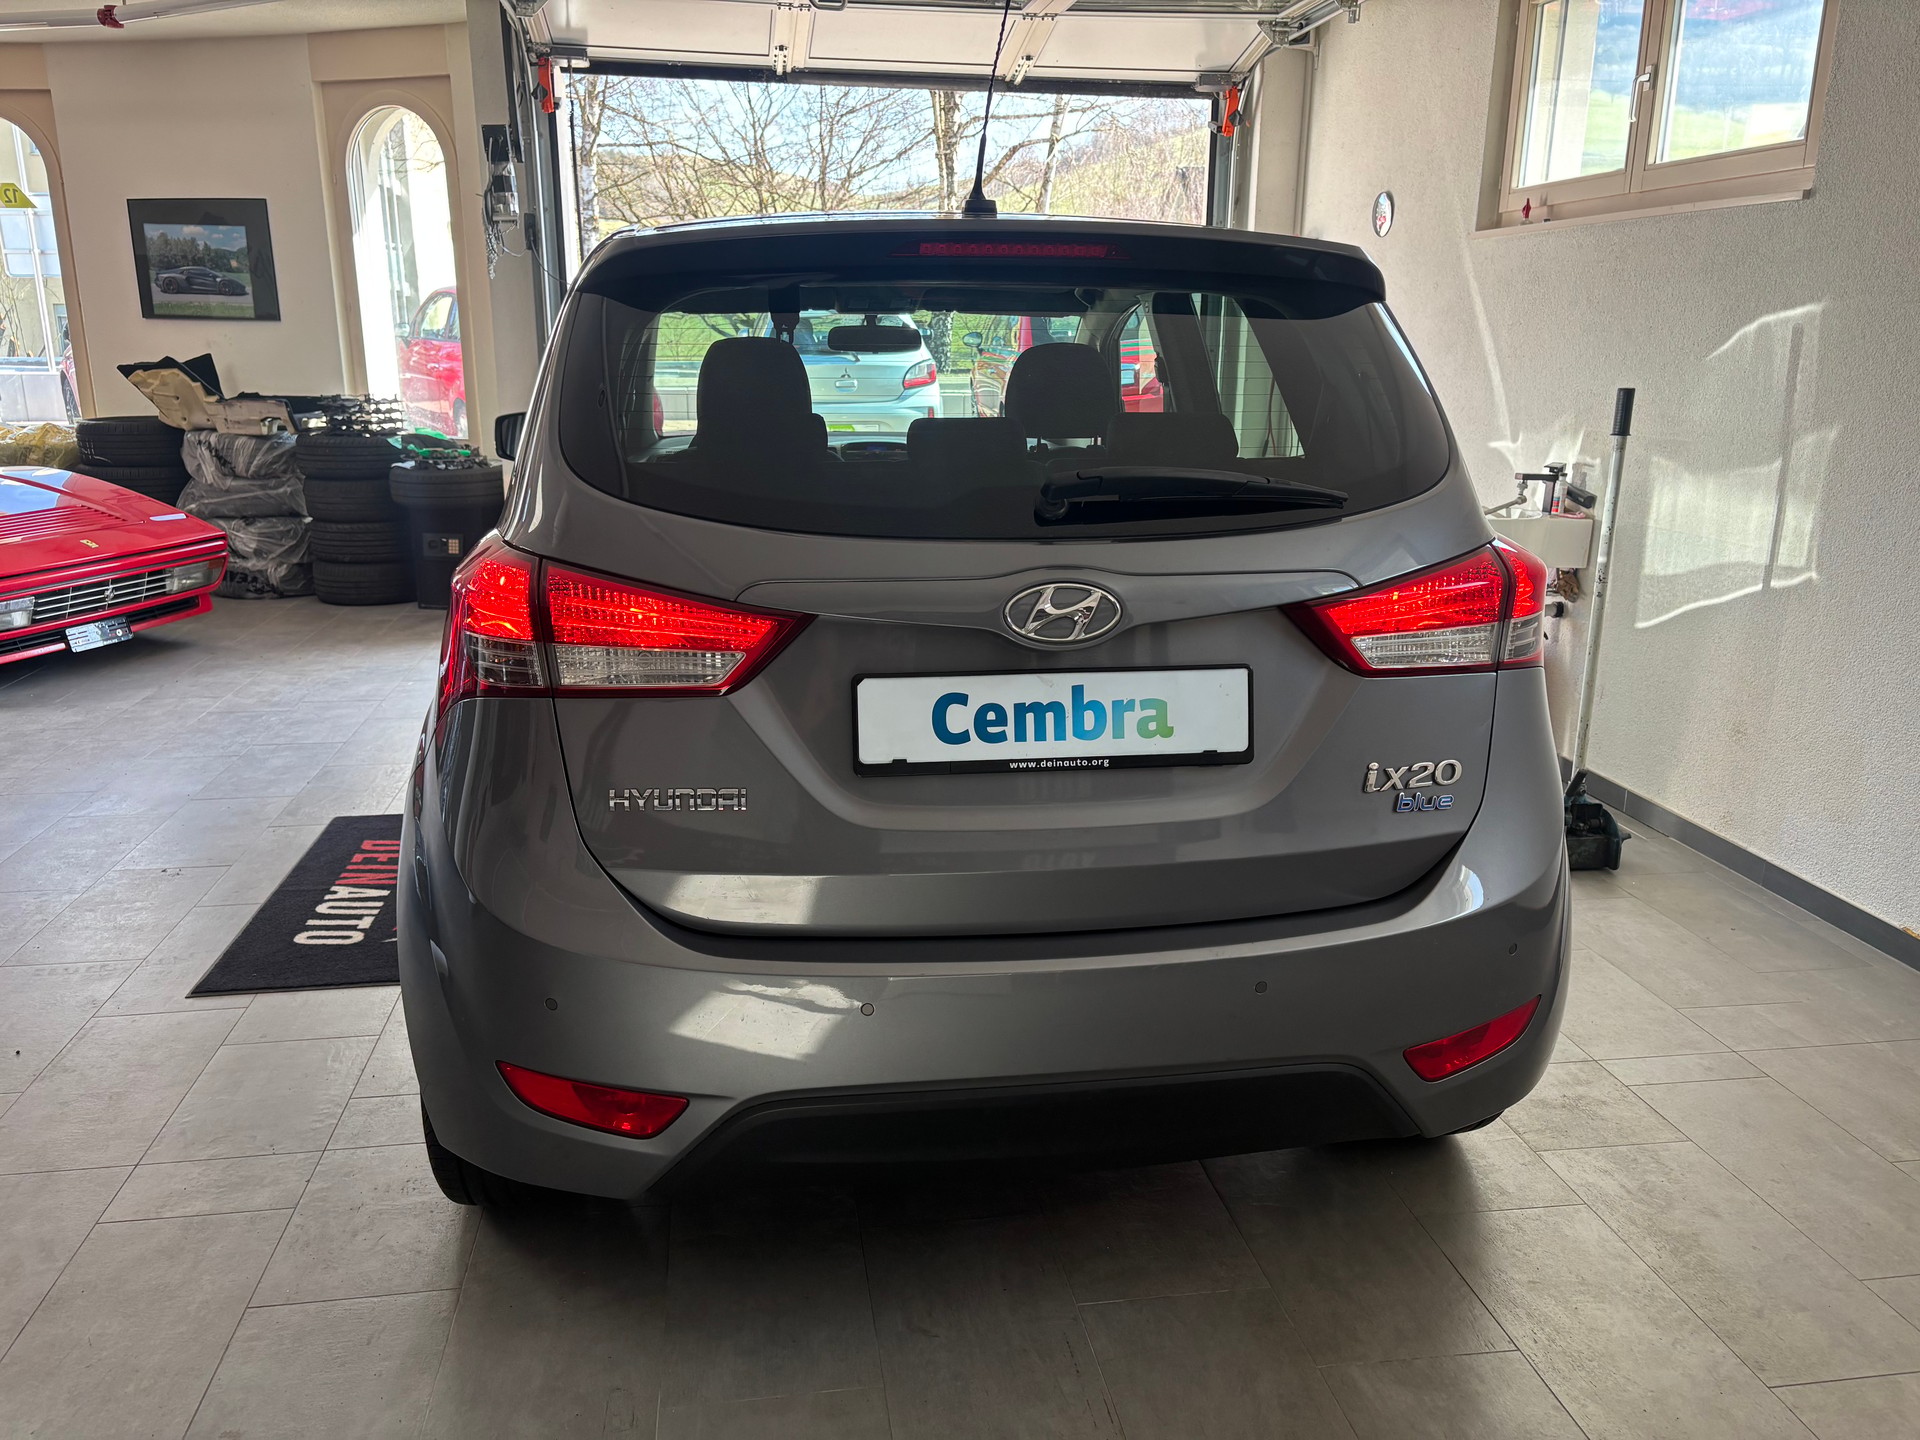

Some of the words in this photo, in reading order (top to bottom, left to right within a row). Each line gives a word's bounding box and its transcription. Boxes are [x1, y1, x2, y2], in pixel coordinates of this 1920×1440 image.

[931, 684, 1174, 745] Cembra
[1009, 759, 1110, 769] www.deinauto.org
[1364, 759, 1463, 793] ix20
[608, 788, 747, 811] HYUNDAI
[1396, 792, 1455, 812] blue
